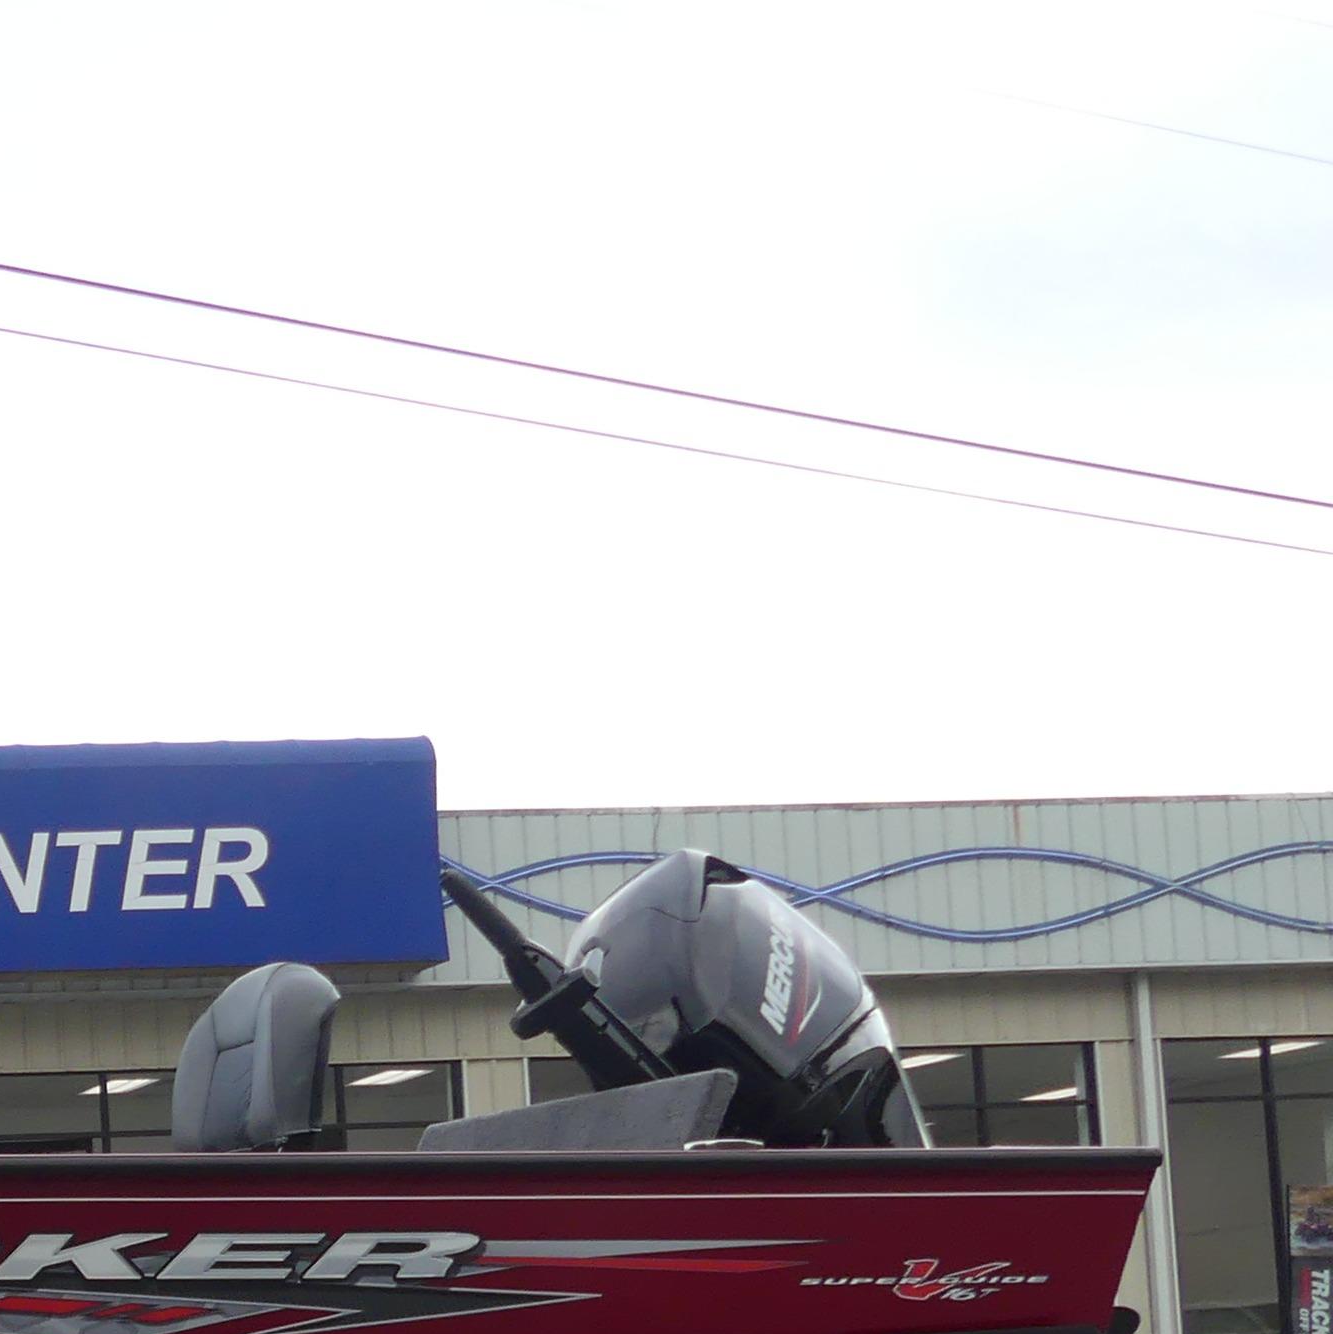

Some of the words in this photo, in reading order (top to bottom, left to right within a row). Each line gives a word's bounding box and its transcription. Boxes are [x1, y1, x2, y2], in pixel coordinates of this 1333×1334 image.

[759, 920, 795, 1036] MERCU
[799, 1276, 925, 1286] SUPER
[937, 1275, 1048, 1285] GUIDE
